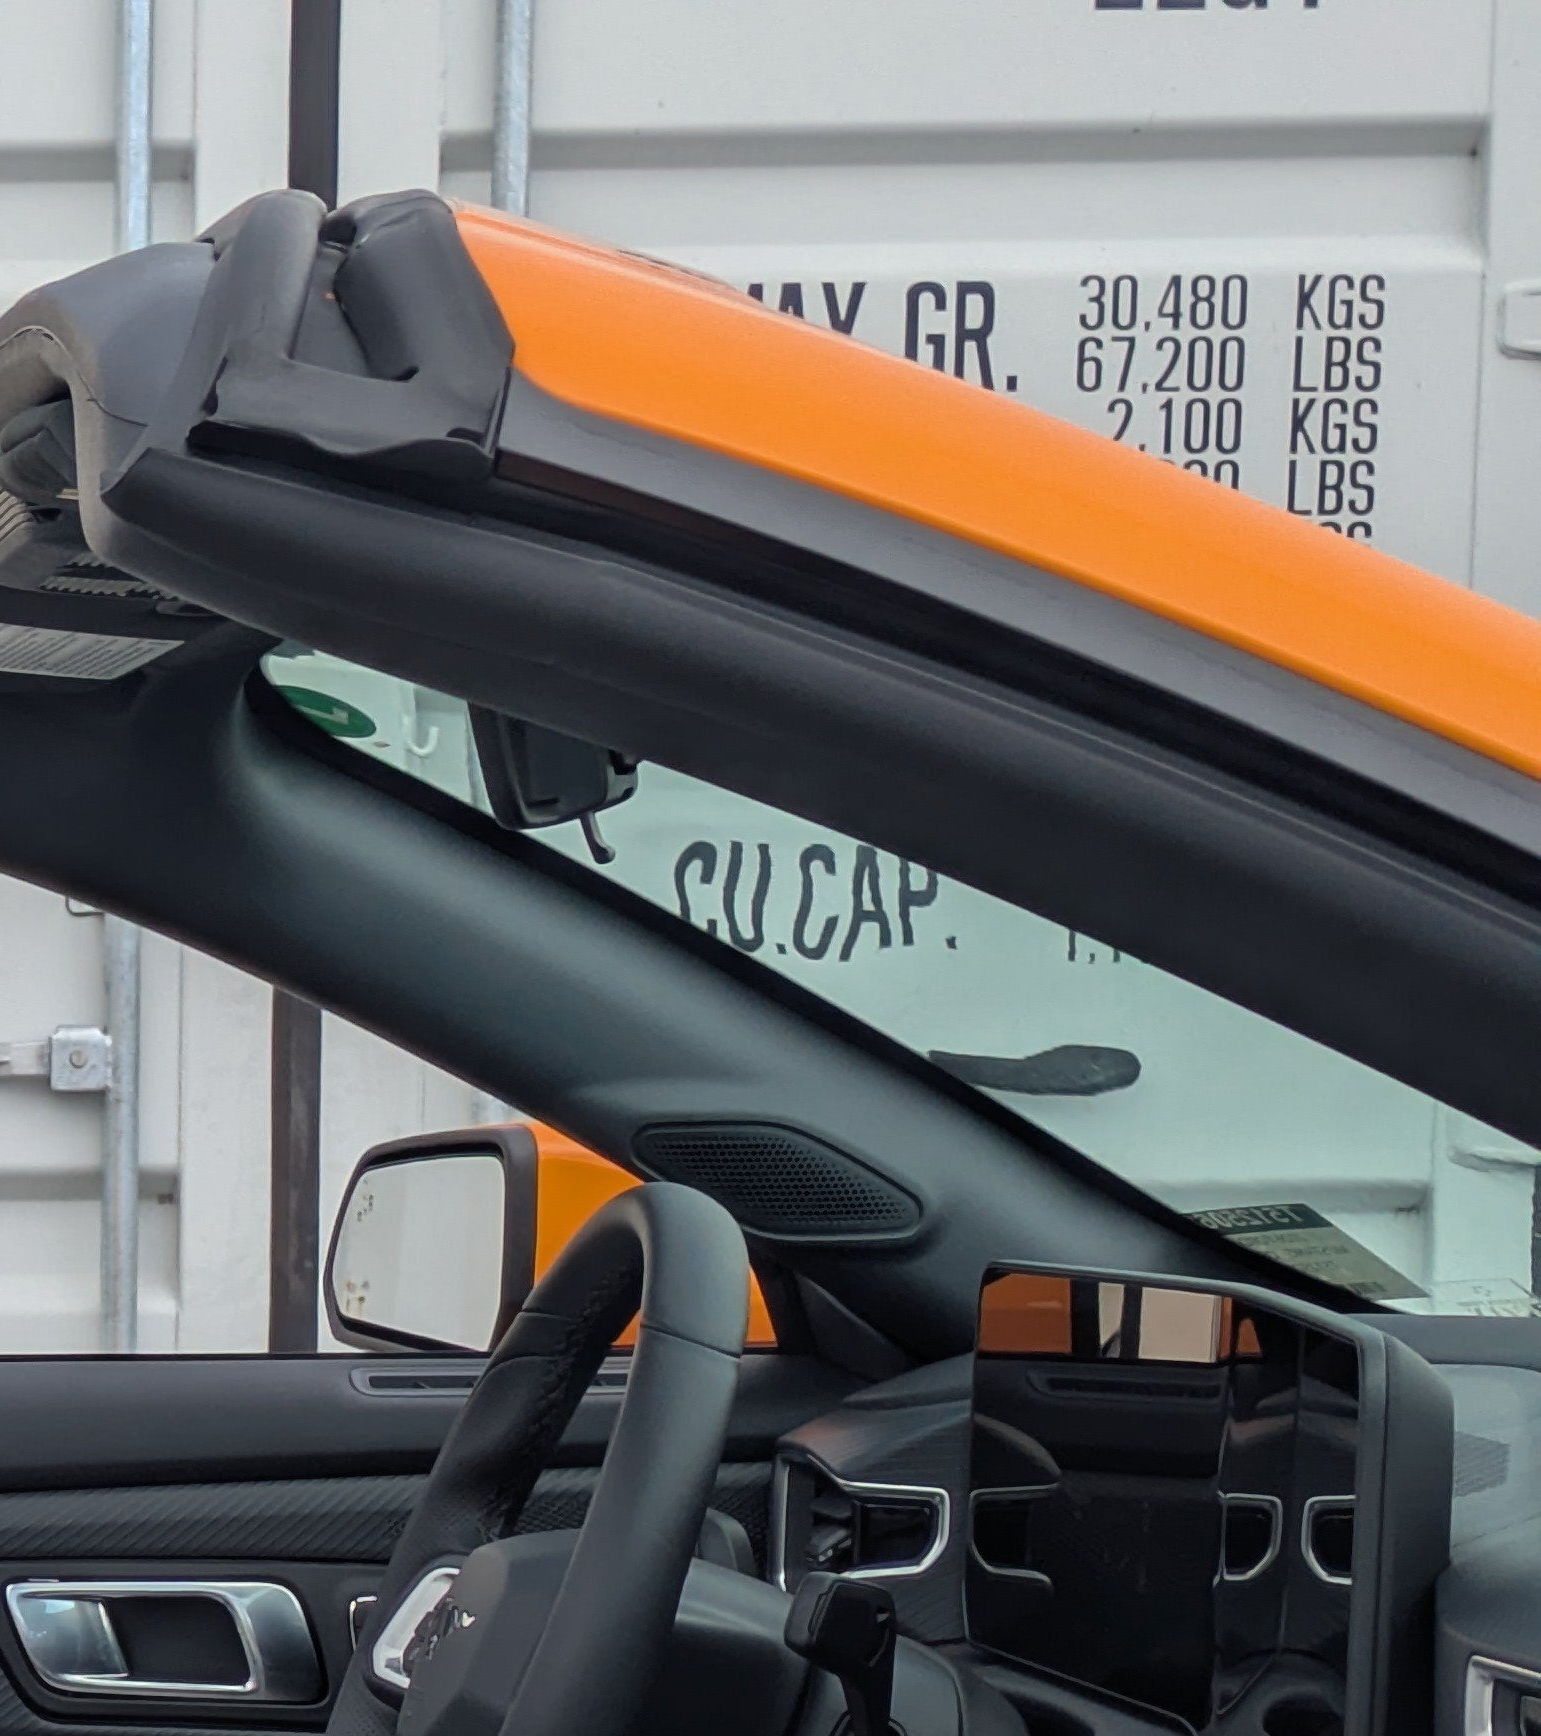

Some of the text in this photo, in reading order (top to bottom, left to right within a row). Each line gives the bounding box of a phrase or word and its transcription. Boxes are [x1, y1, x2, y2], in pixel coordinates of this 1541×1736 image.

[1079, 273, 1385, 332] 30,480 KGS
[904, 280, 1018, 392] GR.
[1076, 335, 1382, 394] 67,200 LBS
[1289, 397, 1379, 455] KGS
[1287, 459, 1376, 517] LBS
